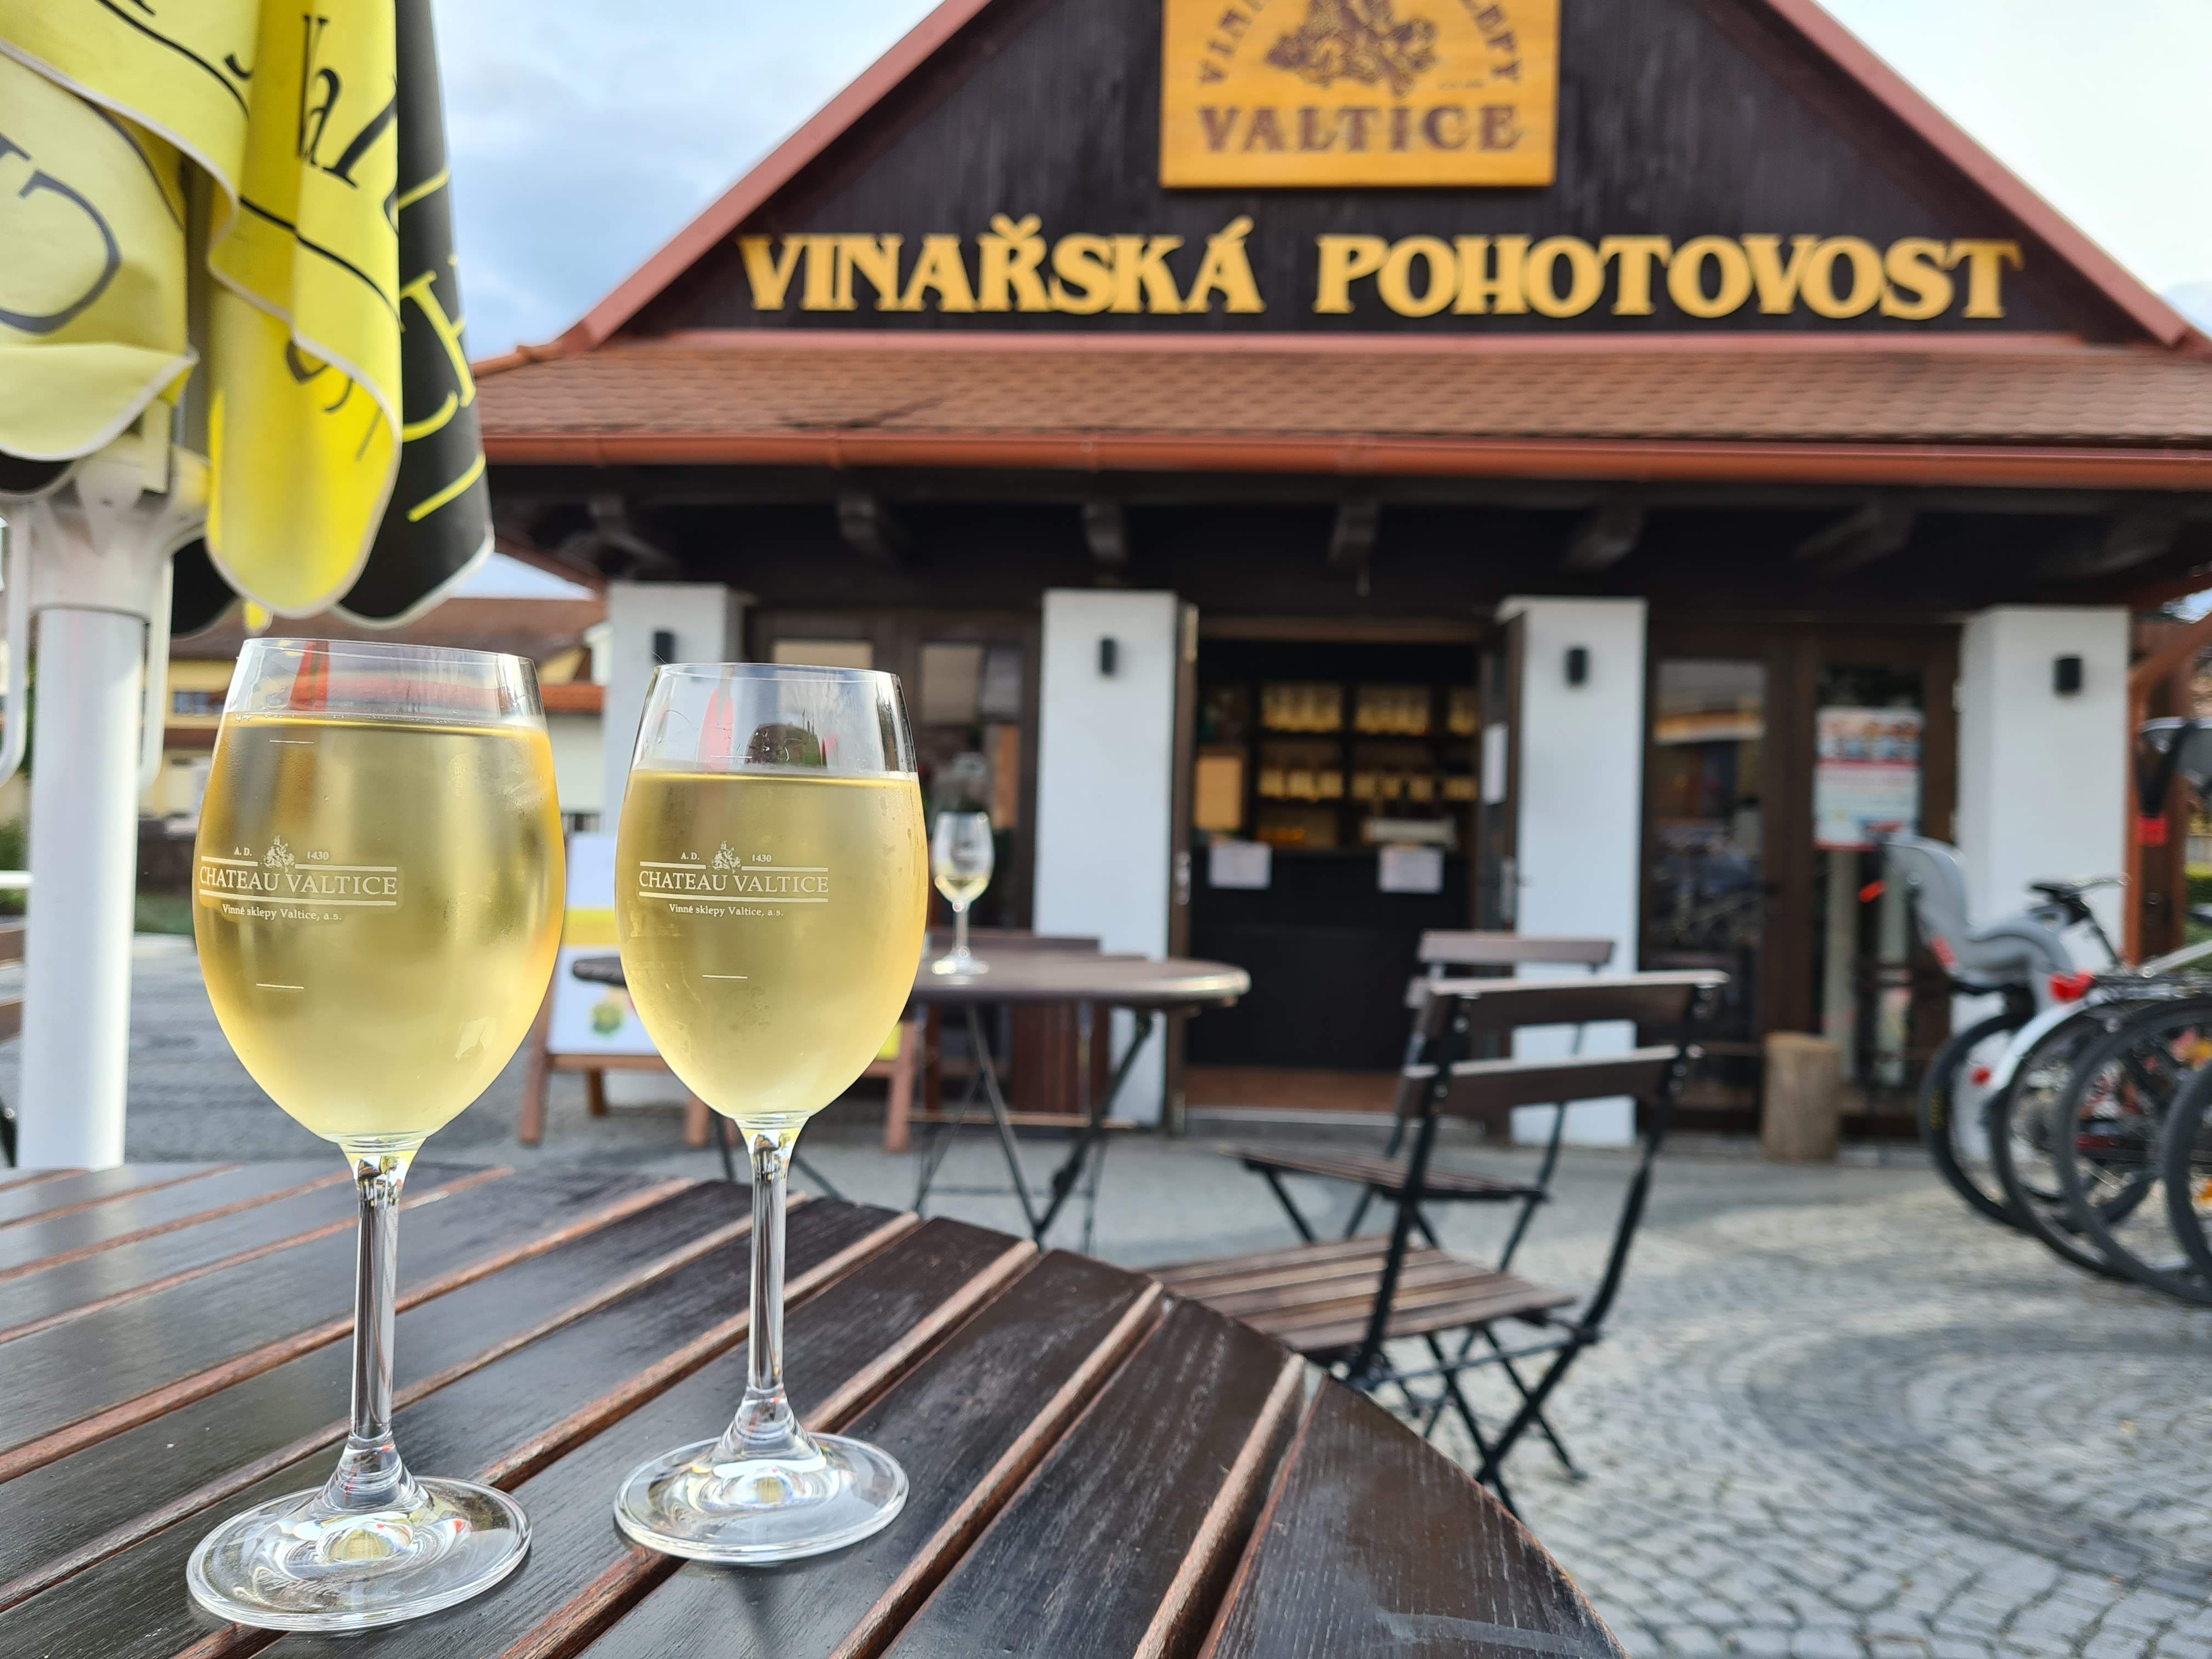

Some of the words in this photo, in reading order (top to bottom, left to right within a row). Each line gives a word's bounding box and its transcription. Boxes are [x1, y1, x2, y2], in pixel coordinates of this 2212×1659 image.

[1197, 104, 1522, 153] VALTICE
[736, 213, 1266, 315] VINAŘSKÁ
[1314, 234, 2024, 320] POHOTOVOST
[234, 847, 242, 856] A.
[244, 848, 252, 856] D.
[307, 851, 329, 861] 1430
[680, 852, 690, 860] A.
[691, 852, 700, 860] D.
[752, 854, 772, 862] 1430
[200, 866, 280, 891] CHATEAU
[285, 873, 398, 895] VALTICE
[639, 870, 728, 891] CHATEAU
[732, 875, 830, 893] VALTICE
[222, 904, 245, 915] Vinné
[247, 906, 277, 921] sklepy
[280, 909, 320, 921] Valtice,
[323, 912, 342, 921] a.s.
[669, 904, 693, 913] Vinné
[696, 906, 725, 917] sklepy
[729, 906, 765, 917] Valtice,
